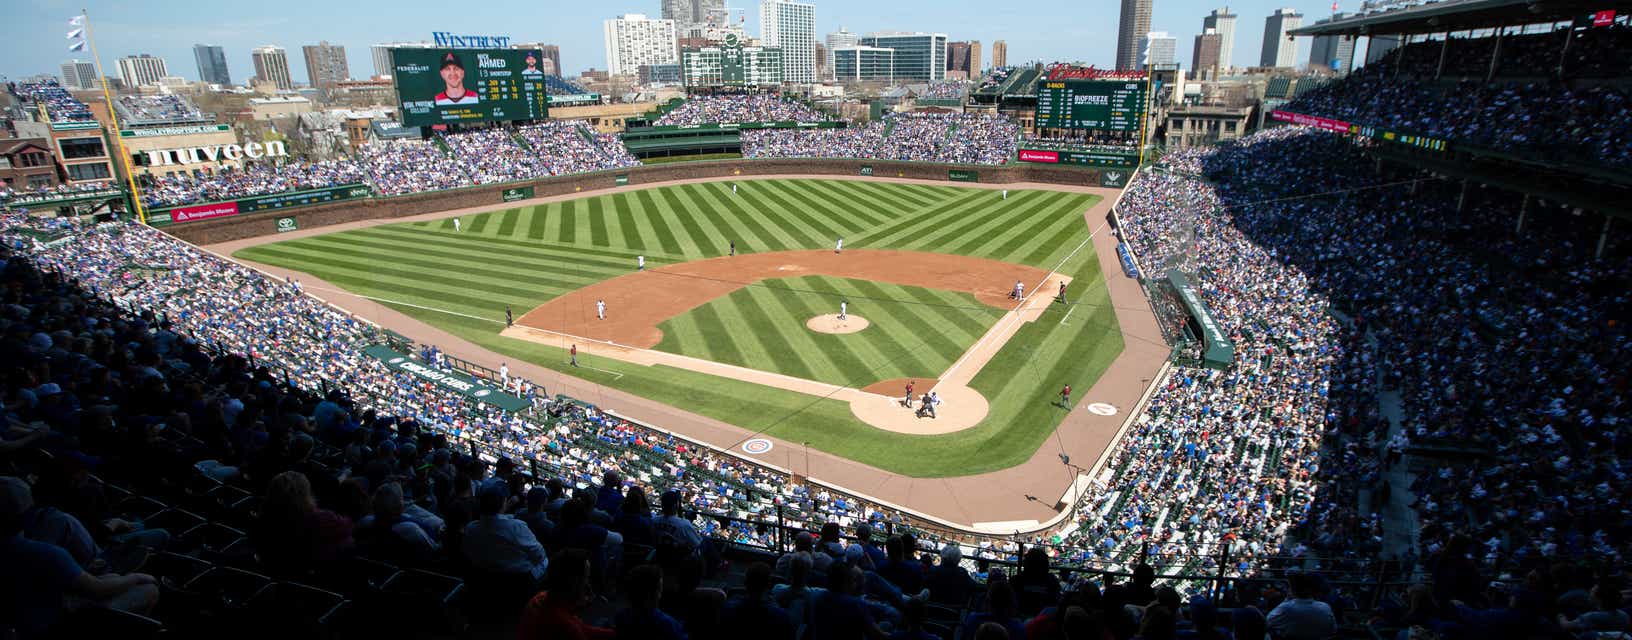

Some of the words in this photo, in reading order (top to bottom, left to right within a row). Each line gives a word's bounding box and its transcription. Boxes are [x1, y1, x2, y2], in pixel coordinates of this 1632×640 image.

[432, 31, 510, 48] WINTRUST
[479, 59, 506, 68] AHMED
[149, 140, 287, 166] nuveen
[188, 210, 215, 218] Benjamin
[215, 207, 235, 215] Moore
[400, 361, 446, 380] CHICAGO
[440, 376, 474, 391] CUBS
